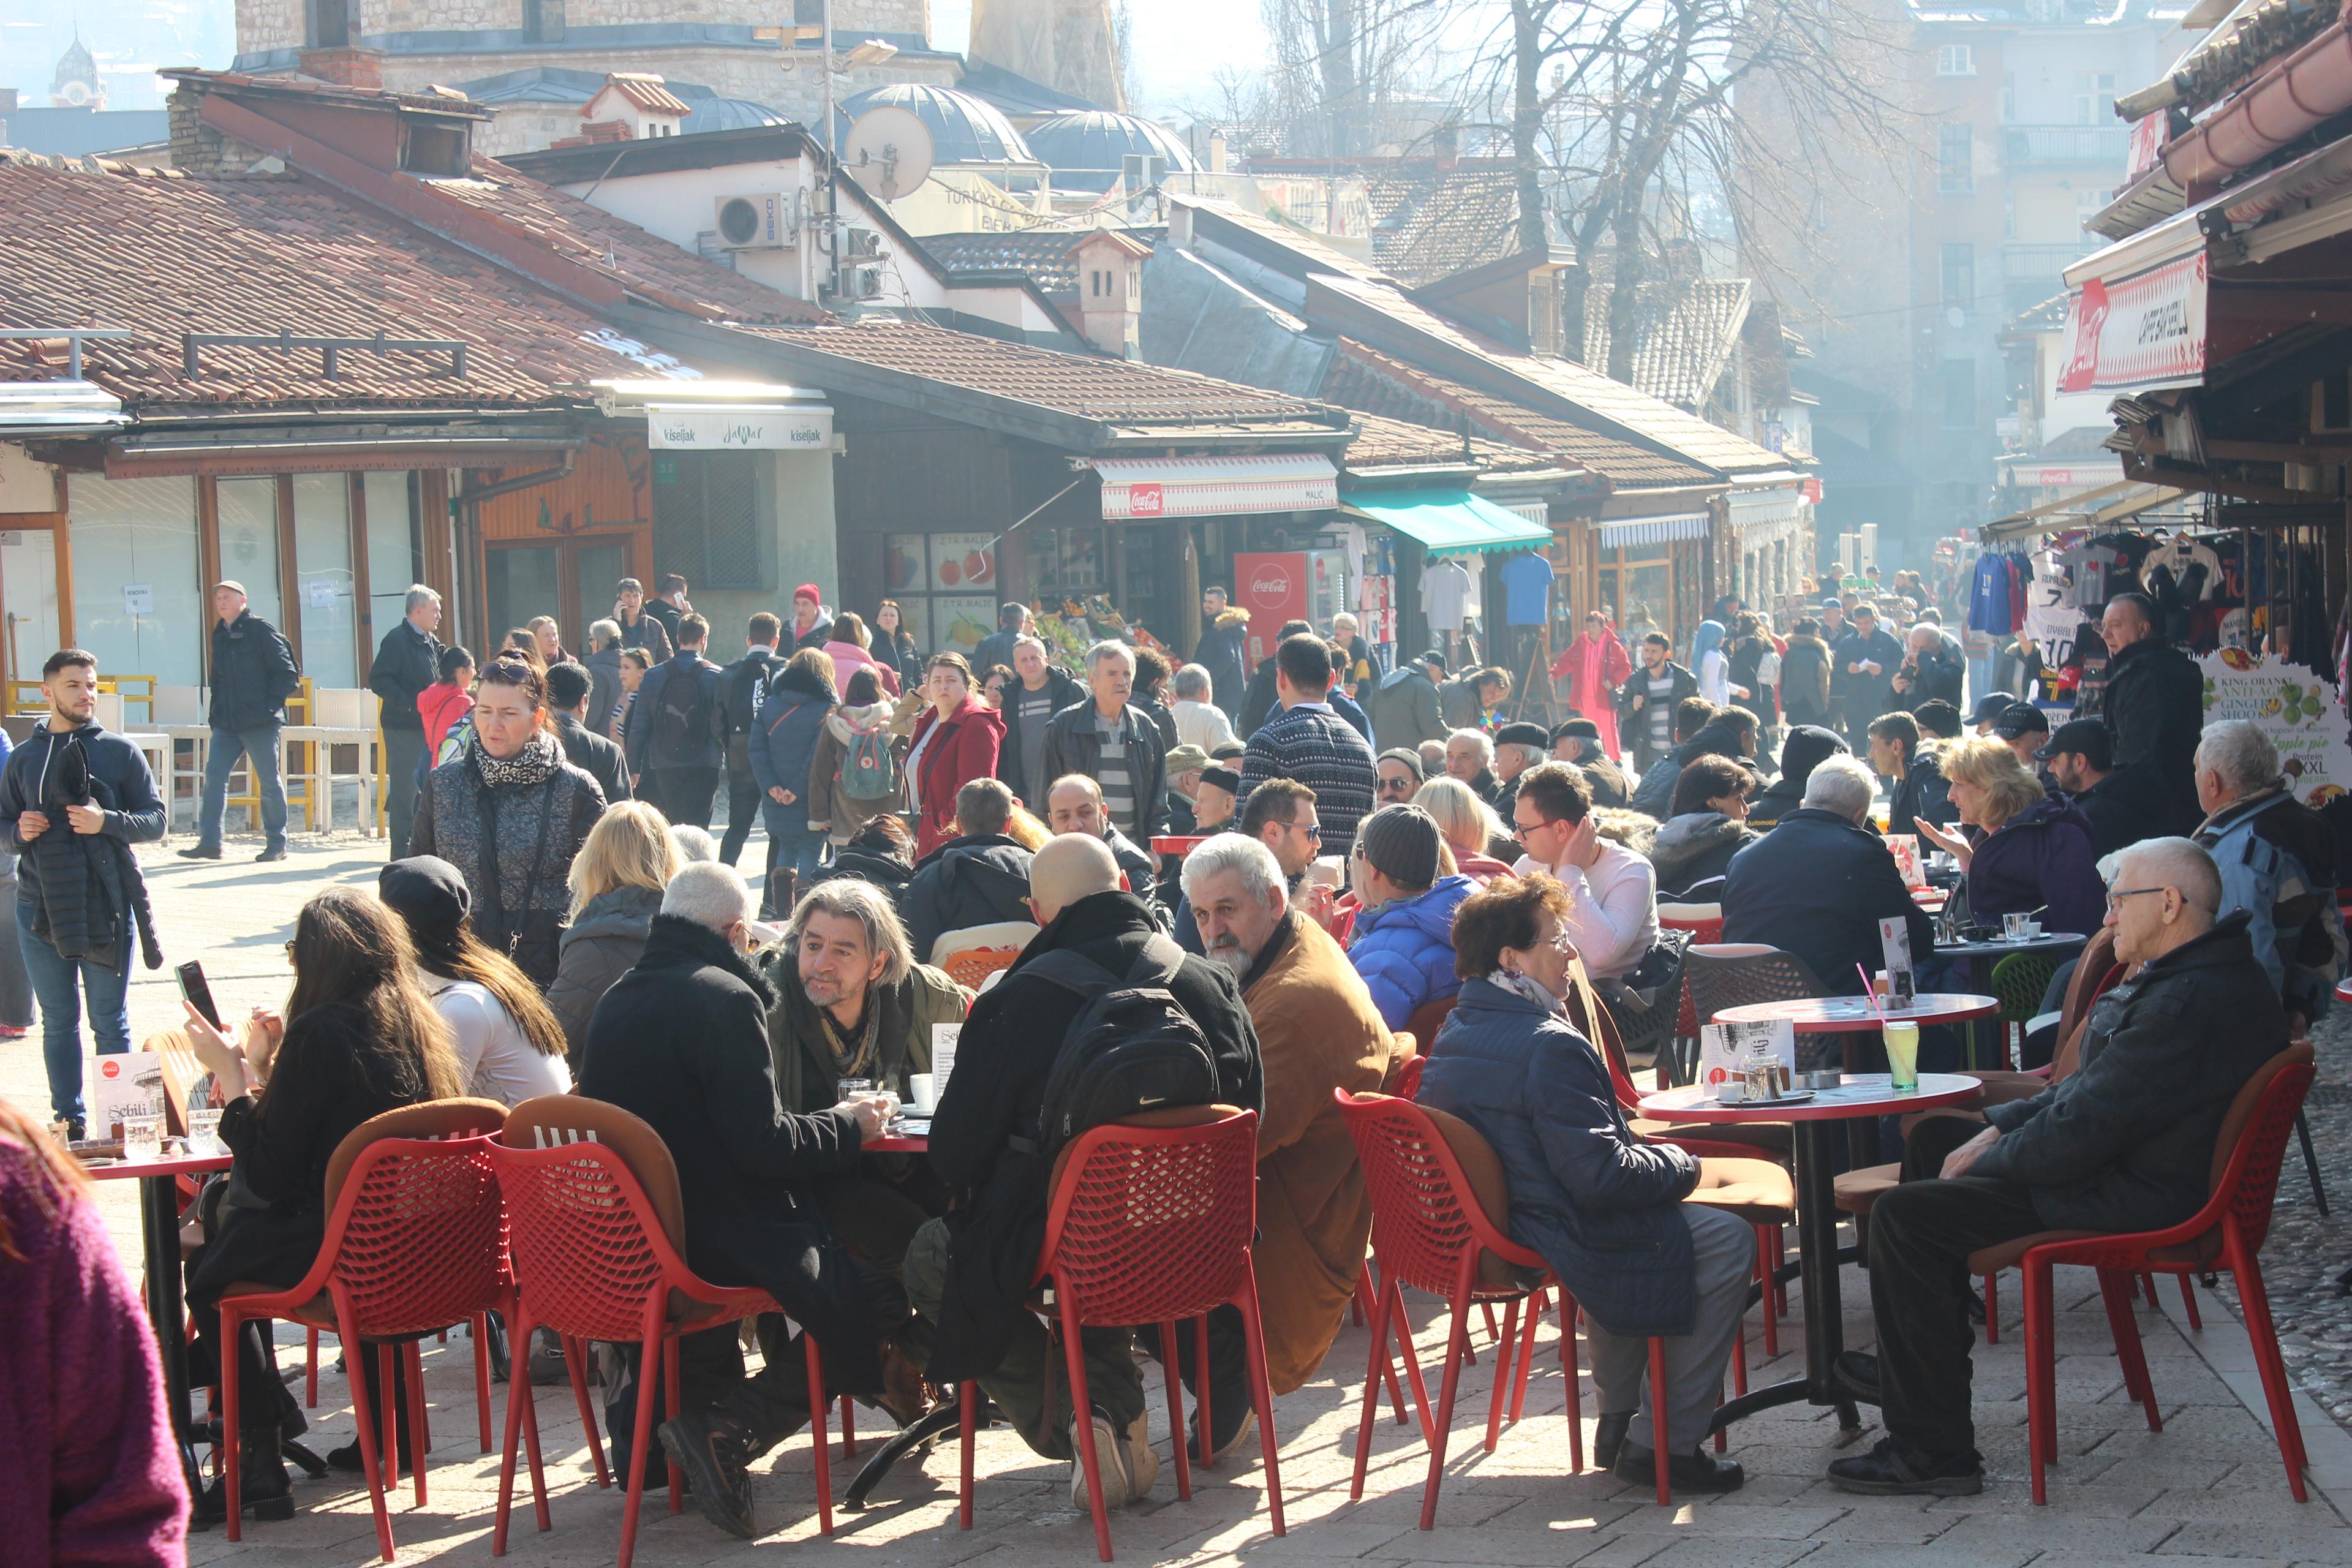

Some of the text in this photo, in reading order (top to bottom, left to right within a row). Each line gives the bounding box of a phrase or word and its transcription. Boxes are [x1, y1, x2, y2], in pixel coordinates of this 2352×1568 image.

[766, 198, 775, 240] BEKO
[664, 429, 695, 443] kiseljak
[791, 429, 821, 443] kiseljak
[1131, 491, 1159, 511] Coca-Cola
[1253, 579, 1287, 593] Coca-Cola
[2039, 589, 2062, 607] 7
[2045, 639, 2074, 671] 10
[2046, 680, 2059, 702] 7
[2307, 736, 2330, 755] pie
